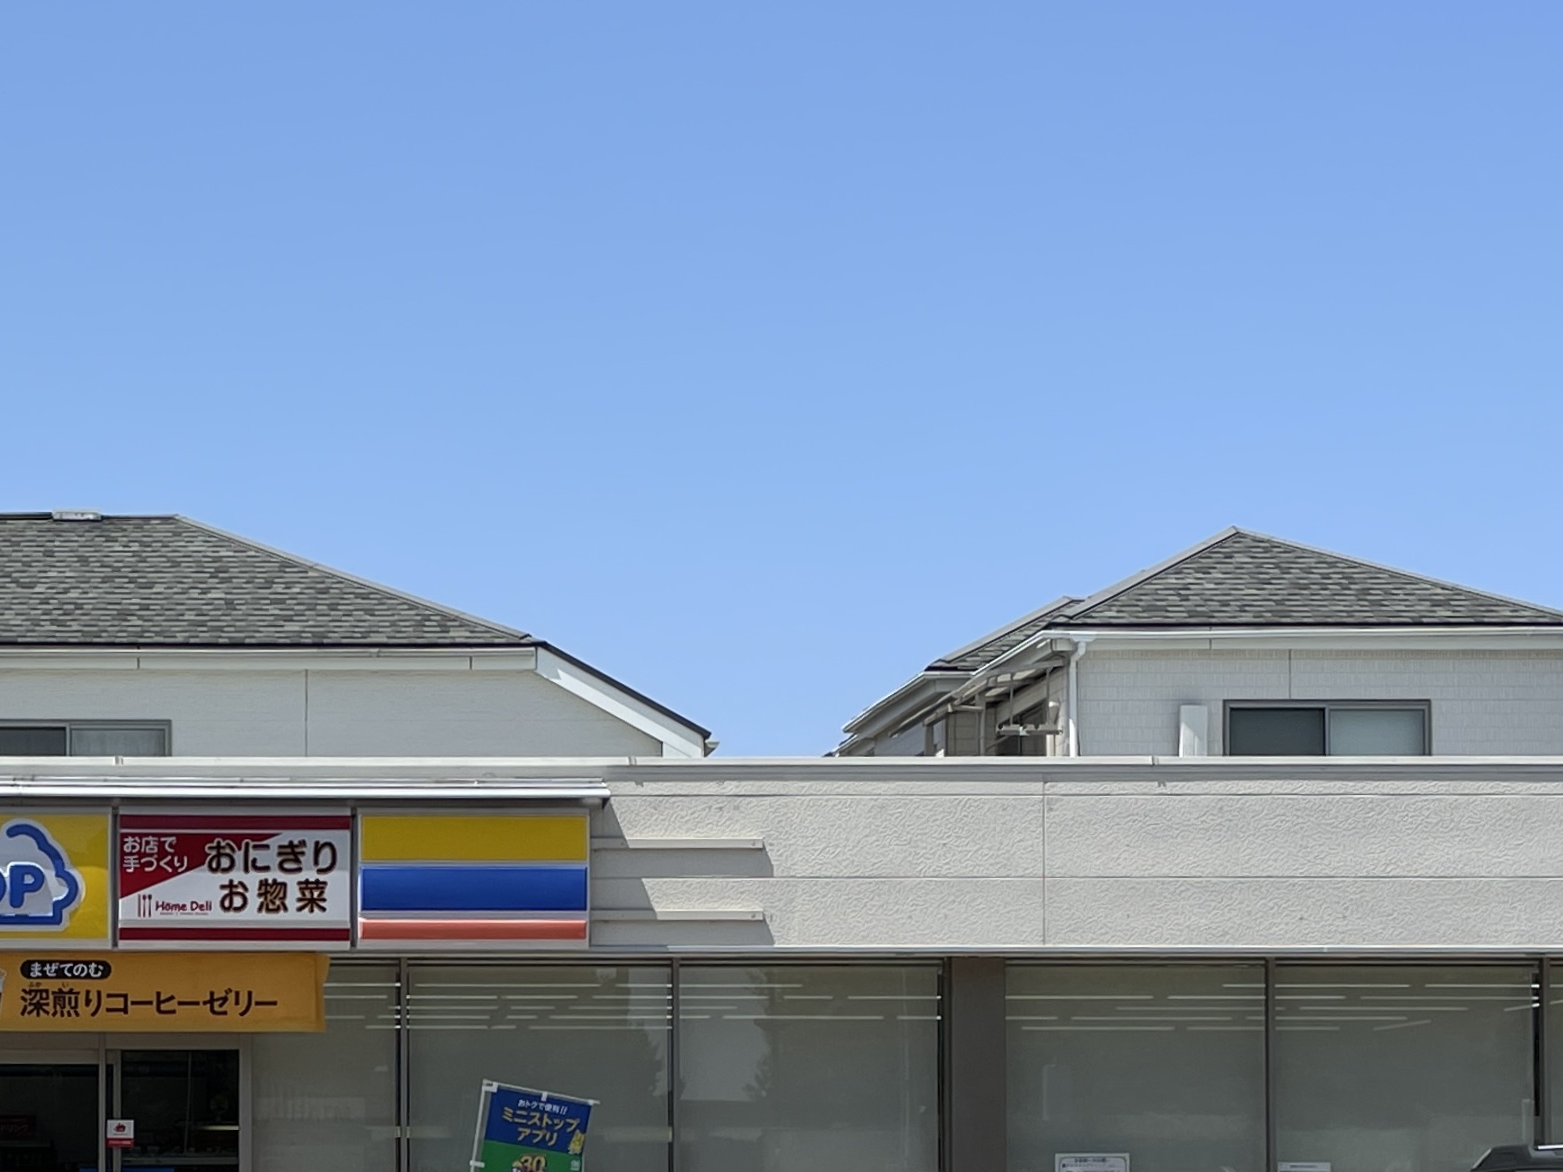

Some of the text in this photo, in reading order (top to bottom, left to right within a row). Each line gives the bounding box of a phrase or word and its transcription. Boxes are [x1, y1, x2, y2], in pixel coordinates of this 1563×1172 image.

[123, 836, 177, 853] お店で
[123, 855, 188, 873] 手づくり
[206, 838, 338, 875] おにぎり
[218, 877, 329, 914] お惣菜
[155, 900, 212, 912] Home Deli
[30, 962, 104, 978] まぜてのむ
[20, 988, 279, 1018] 深煎りコーヒーゼリー
[501, 1106, 581, 1133] ミニストップ
[517, 1127, 558, 1147] アプリ
